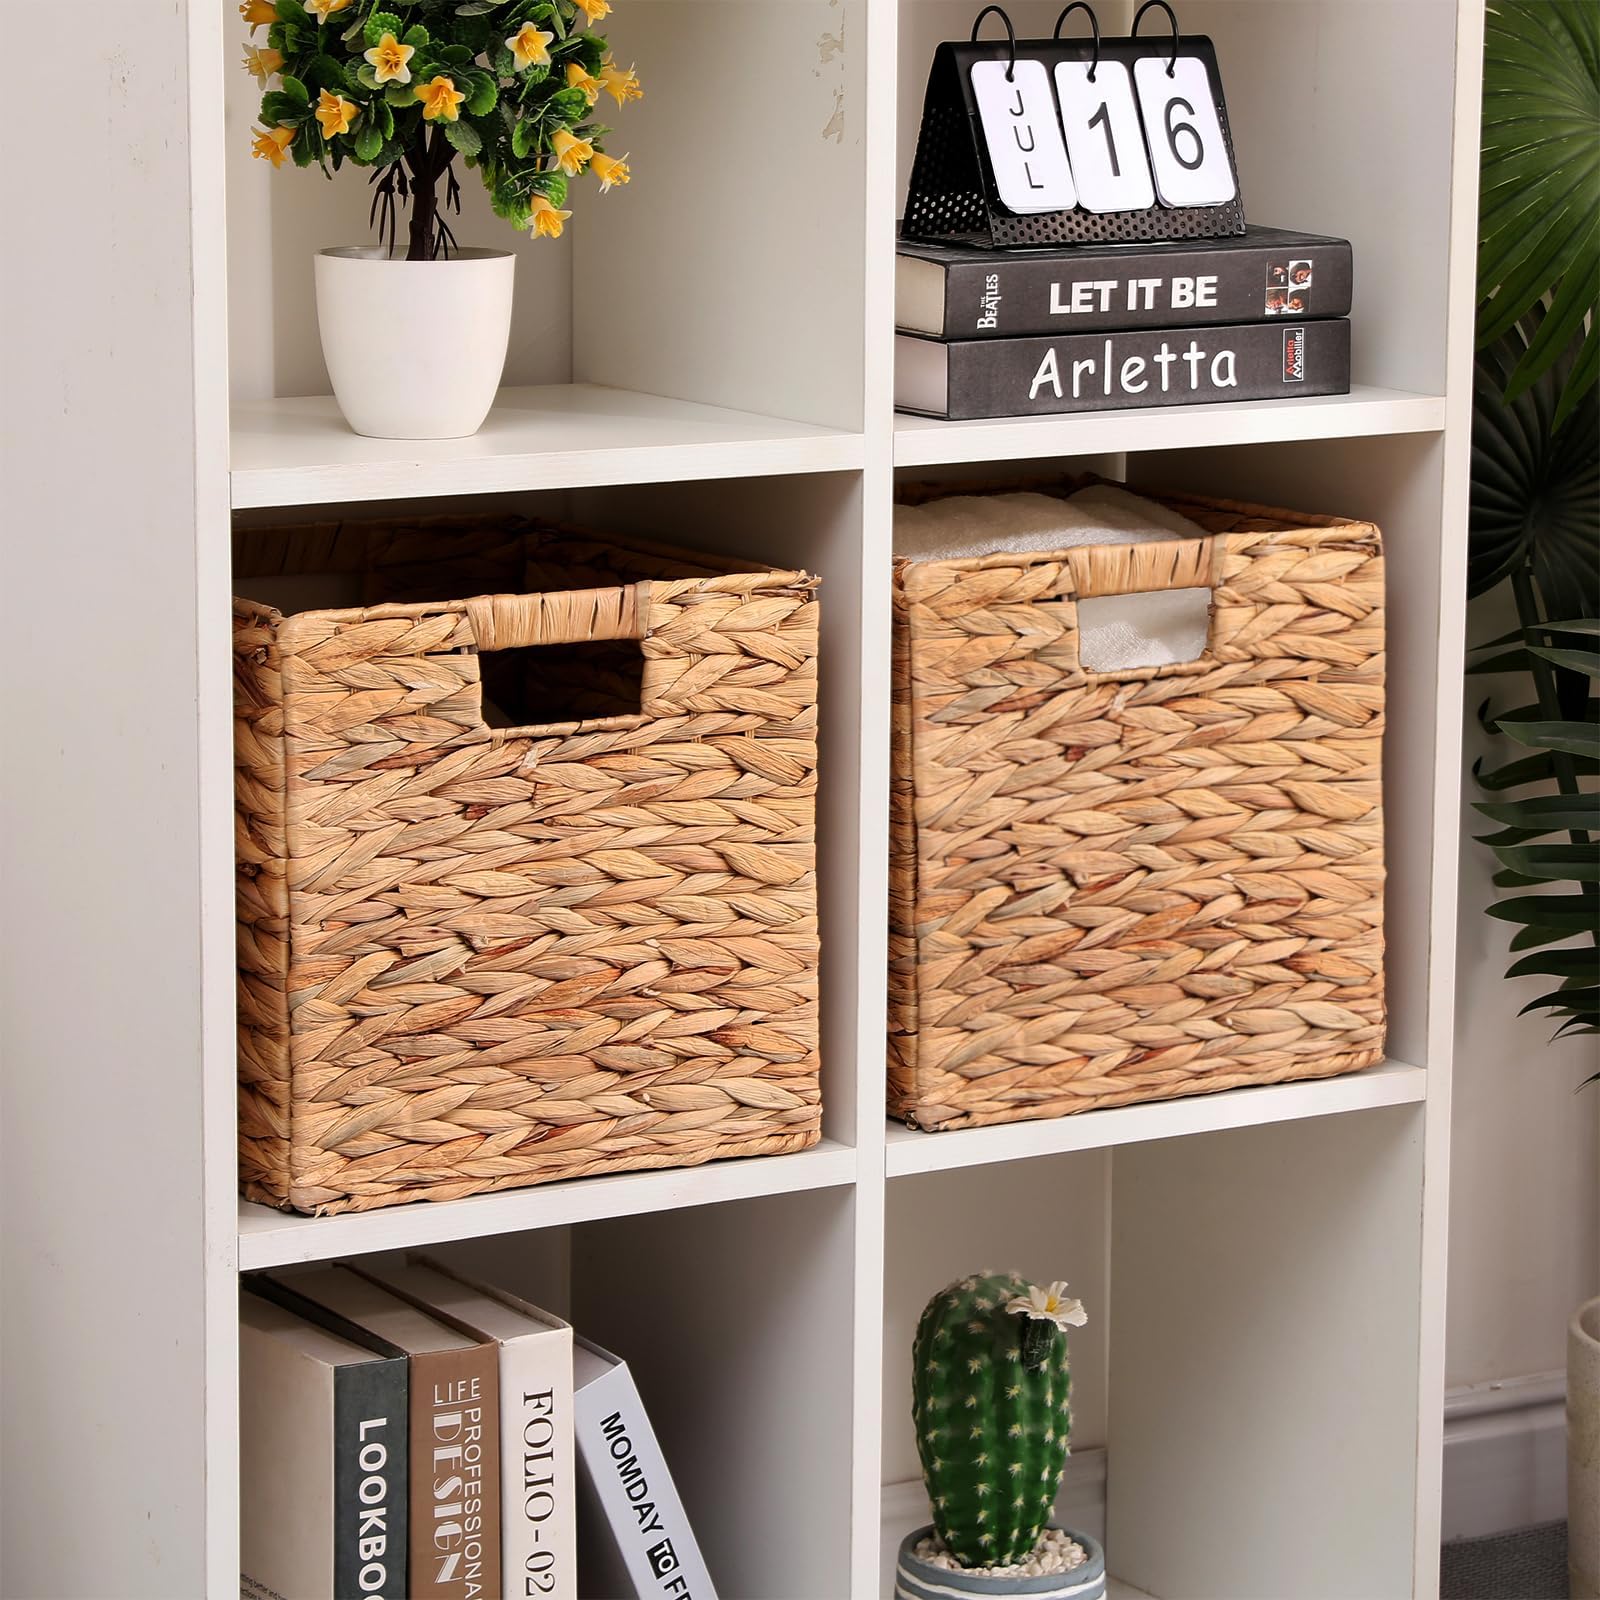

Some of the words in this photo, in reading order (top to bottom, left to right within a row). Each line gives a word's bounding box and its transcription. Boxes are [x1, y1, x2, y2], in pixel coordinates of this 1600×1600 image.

[1009, 89, 1044, 189] JUL
[976, 273, 1002, 330] BEATLES
[1050, 280, 1118, 315] LET
[1127, 278, 1162, 311] IT
[1171, 275, 1218, 309] BE
[1028, 339, 1238, 400] Arletta
[433, 1377, 481, 1404] LIFE
[433, 1410, 463, 1584] DESIGN
[464, 1406, 482, 1600] PROFESSIONA
[523, 1386, 555, 1522] FOLIO
[599, 1411, 664, 1535] MOMDAY
[653, 1541, 675, 1574] TO
[358, 1417, 387, 1600] LOOKBO
[525, 1551, 556, 1597] 02
